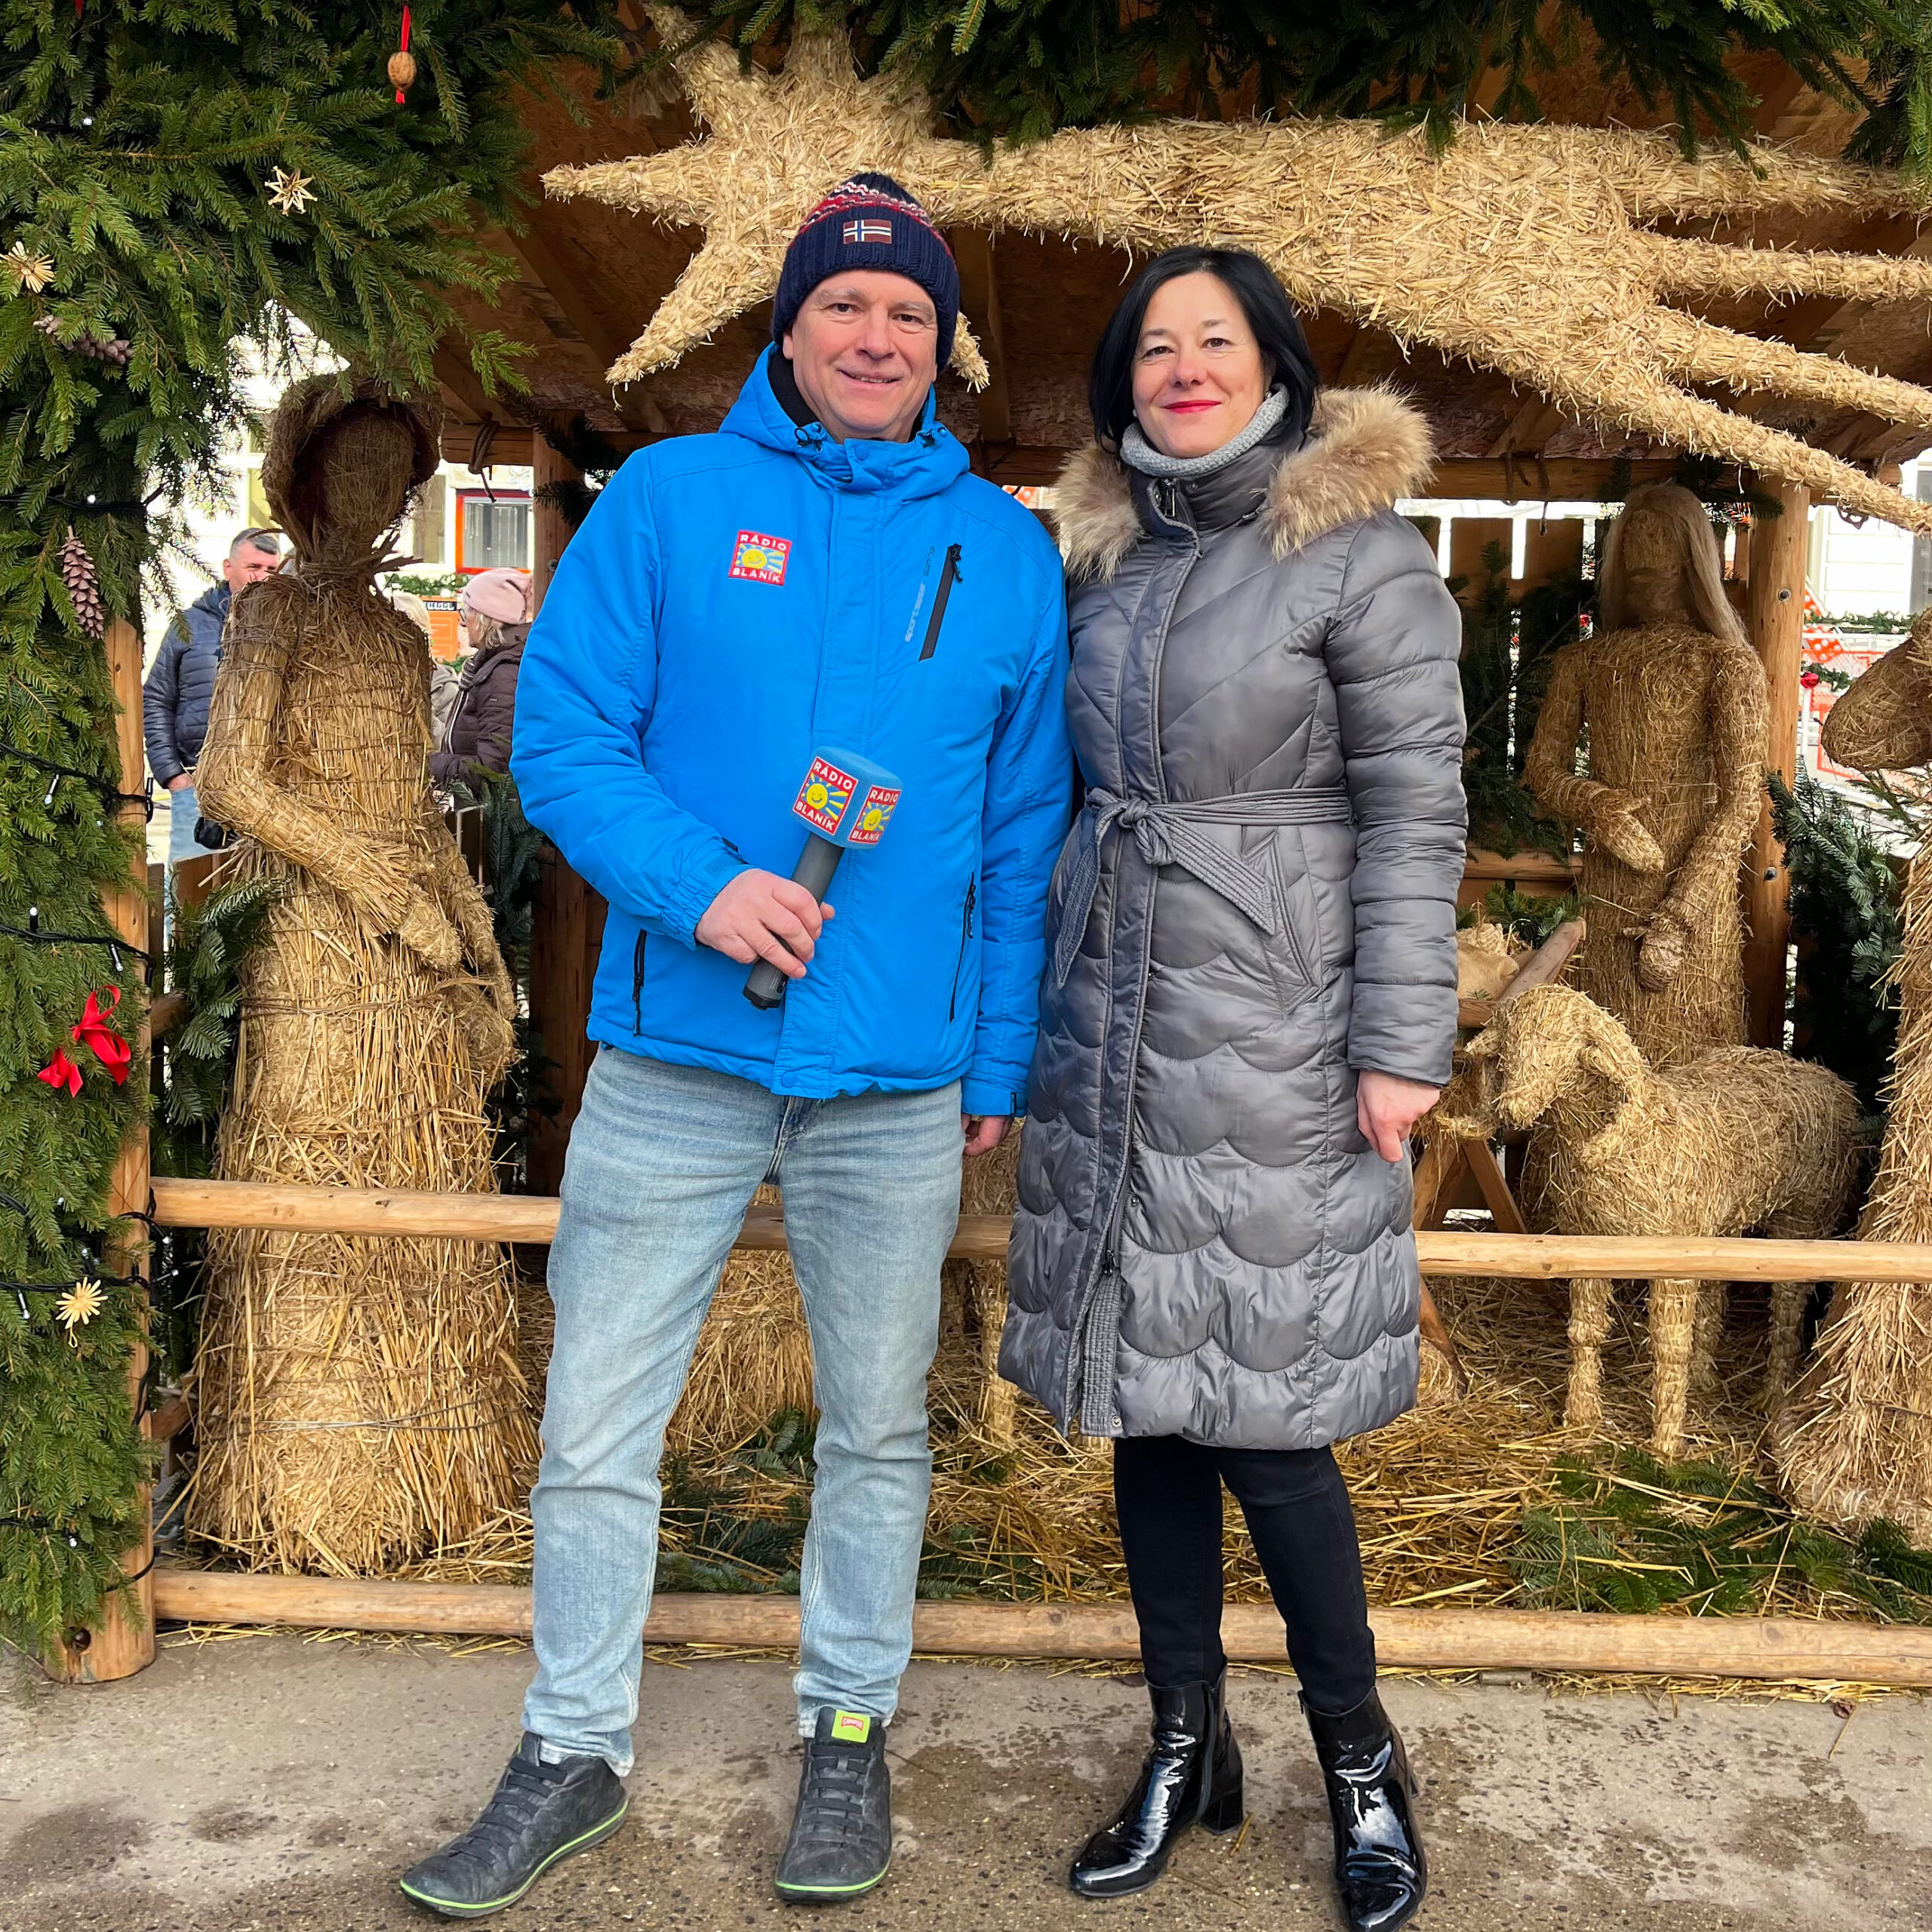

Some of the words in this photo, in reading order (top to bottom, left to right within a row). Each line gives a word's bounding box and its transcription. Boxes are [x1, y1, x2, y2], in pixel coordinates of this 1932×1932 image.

[740, 534, 787, 551] RÁDIO
[732, 567, 781, 583] BLANÍK
[813, 761, 853, 790] RÁDIO
[869, 789, 899, 803] RÁDIO
[795, 801, 835, 831] BLANÍK
[851, 830, 881, 841] BLANÍK
